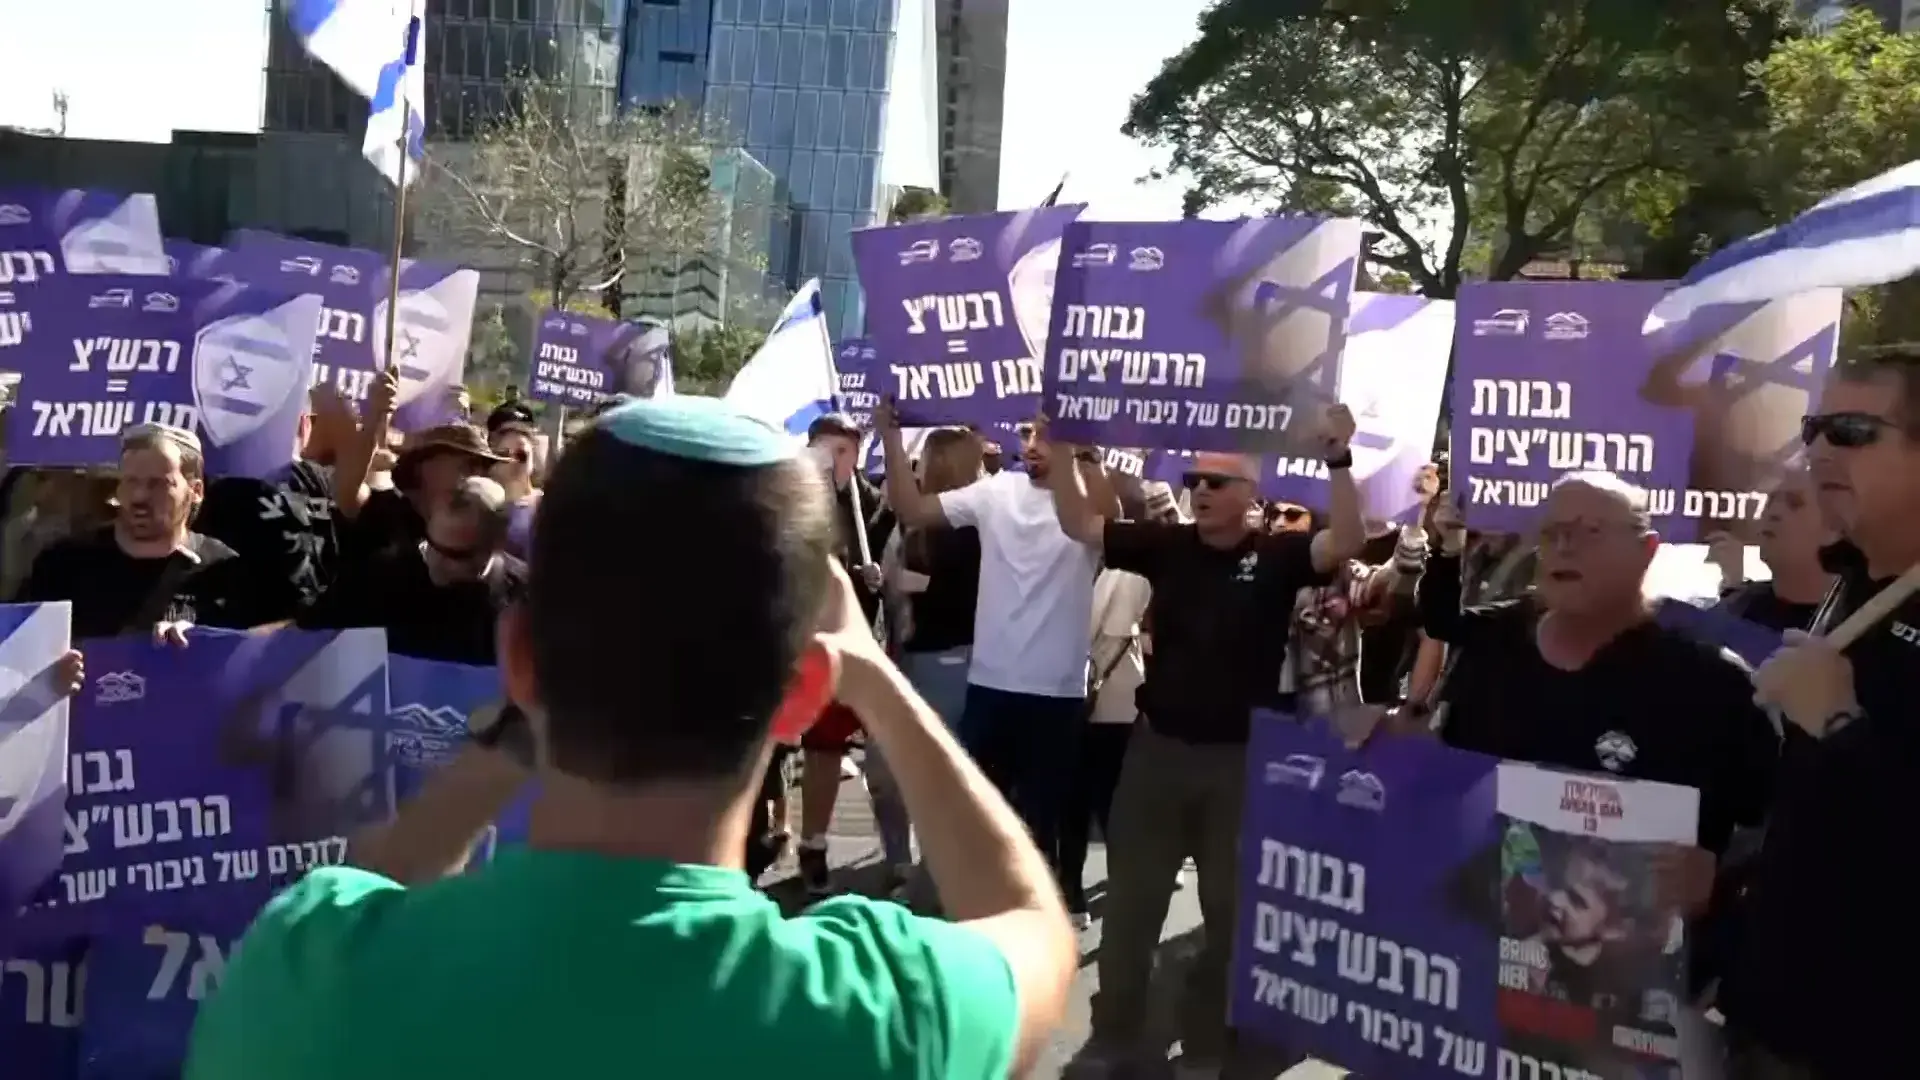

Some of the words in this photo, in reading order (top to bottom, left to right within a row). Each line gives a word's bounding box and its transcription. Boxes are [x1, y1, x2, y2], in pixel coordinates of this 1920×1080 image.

[0, 251, 54, 283] רבש
[902, 291, 1004, 334] רבש"צ
[1062, 304, 1145, 340] גבורת
[69, 336, 181, 372] רבש"צ
[1058, 348, 1206, 388] הרבש"צים
[889, 361, 984, 400] ישראל
[991, 357, 1043, 399] מגן
[1056, 393, 1120, 421] ישראל
[1126, 397, 1179, 425] גיבורי
[1185, 400, 1220, 428] של
[1225, 403, 1292, 431] לזכרם
[1470, 379, 1571, 418] גבורת
[32, 400, 135, 436] ישראל
[1470, 427, 1654, 472] הרבש"צים
[1468, 475, 1549, 507] ישראל
[1648, 489, 1675, 516] ש
[1683, 489, 1768, 520] לזכרם
[71, 749, 135, 795] גבו
[63, 795, 231, 854] הרבש"צ
[127, 856, 207, 891] גיבורי
[213, 849, 258, 882] של
[1257, 838, 1365, 914] גבורת
[59, 867, 117, 904] ישר
[1253, 902, 1460, 1011] הרבש"צים
[1251, 964, 1338, 1025] ישראל
[1346, 1000, 1424, 1059] גיבורי
[1433, 1026, 1486, 1076] של
